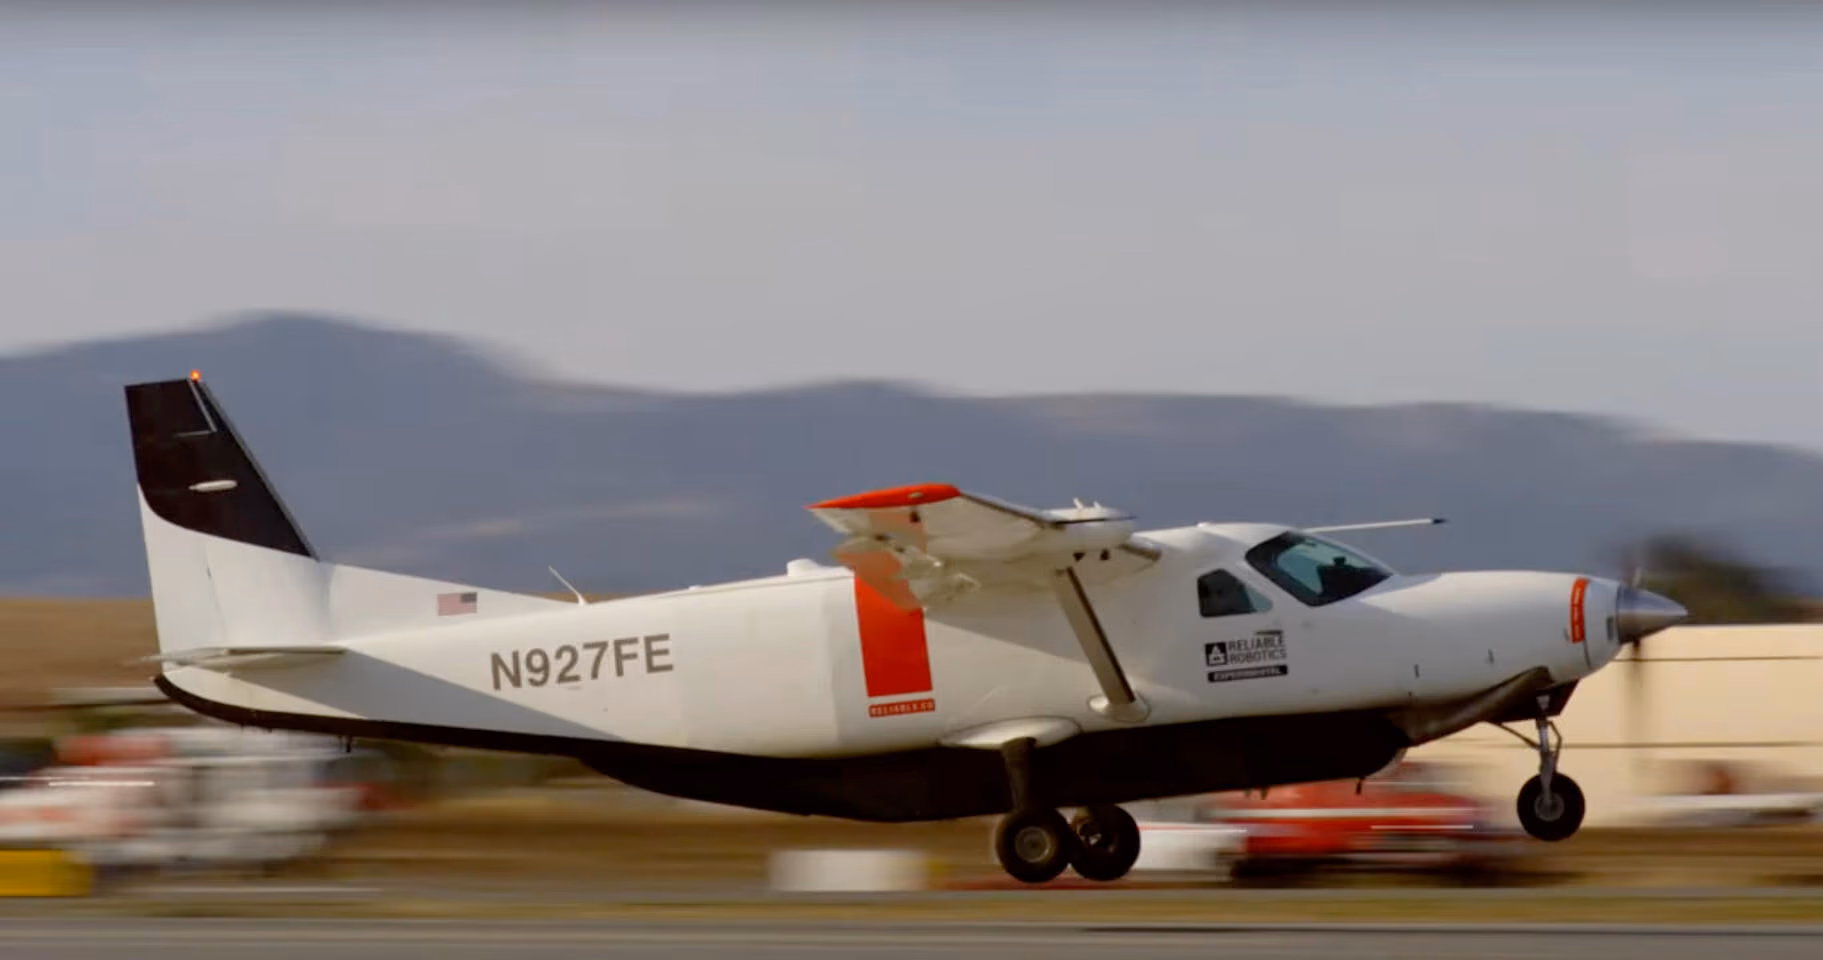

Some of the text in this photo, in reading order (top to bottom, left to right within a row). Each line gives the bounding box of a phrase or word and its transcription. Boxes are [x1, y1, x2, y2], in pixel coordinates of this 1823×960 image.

[1228, 635, 1286, 652] RELIABLE
[490, 633, 674, 691] N927FE
[1229, 648, 1287, 665] ROBOTICS
